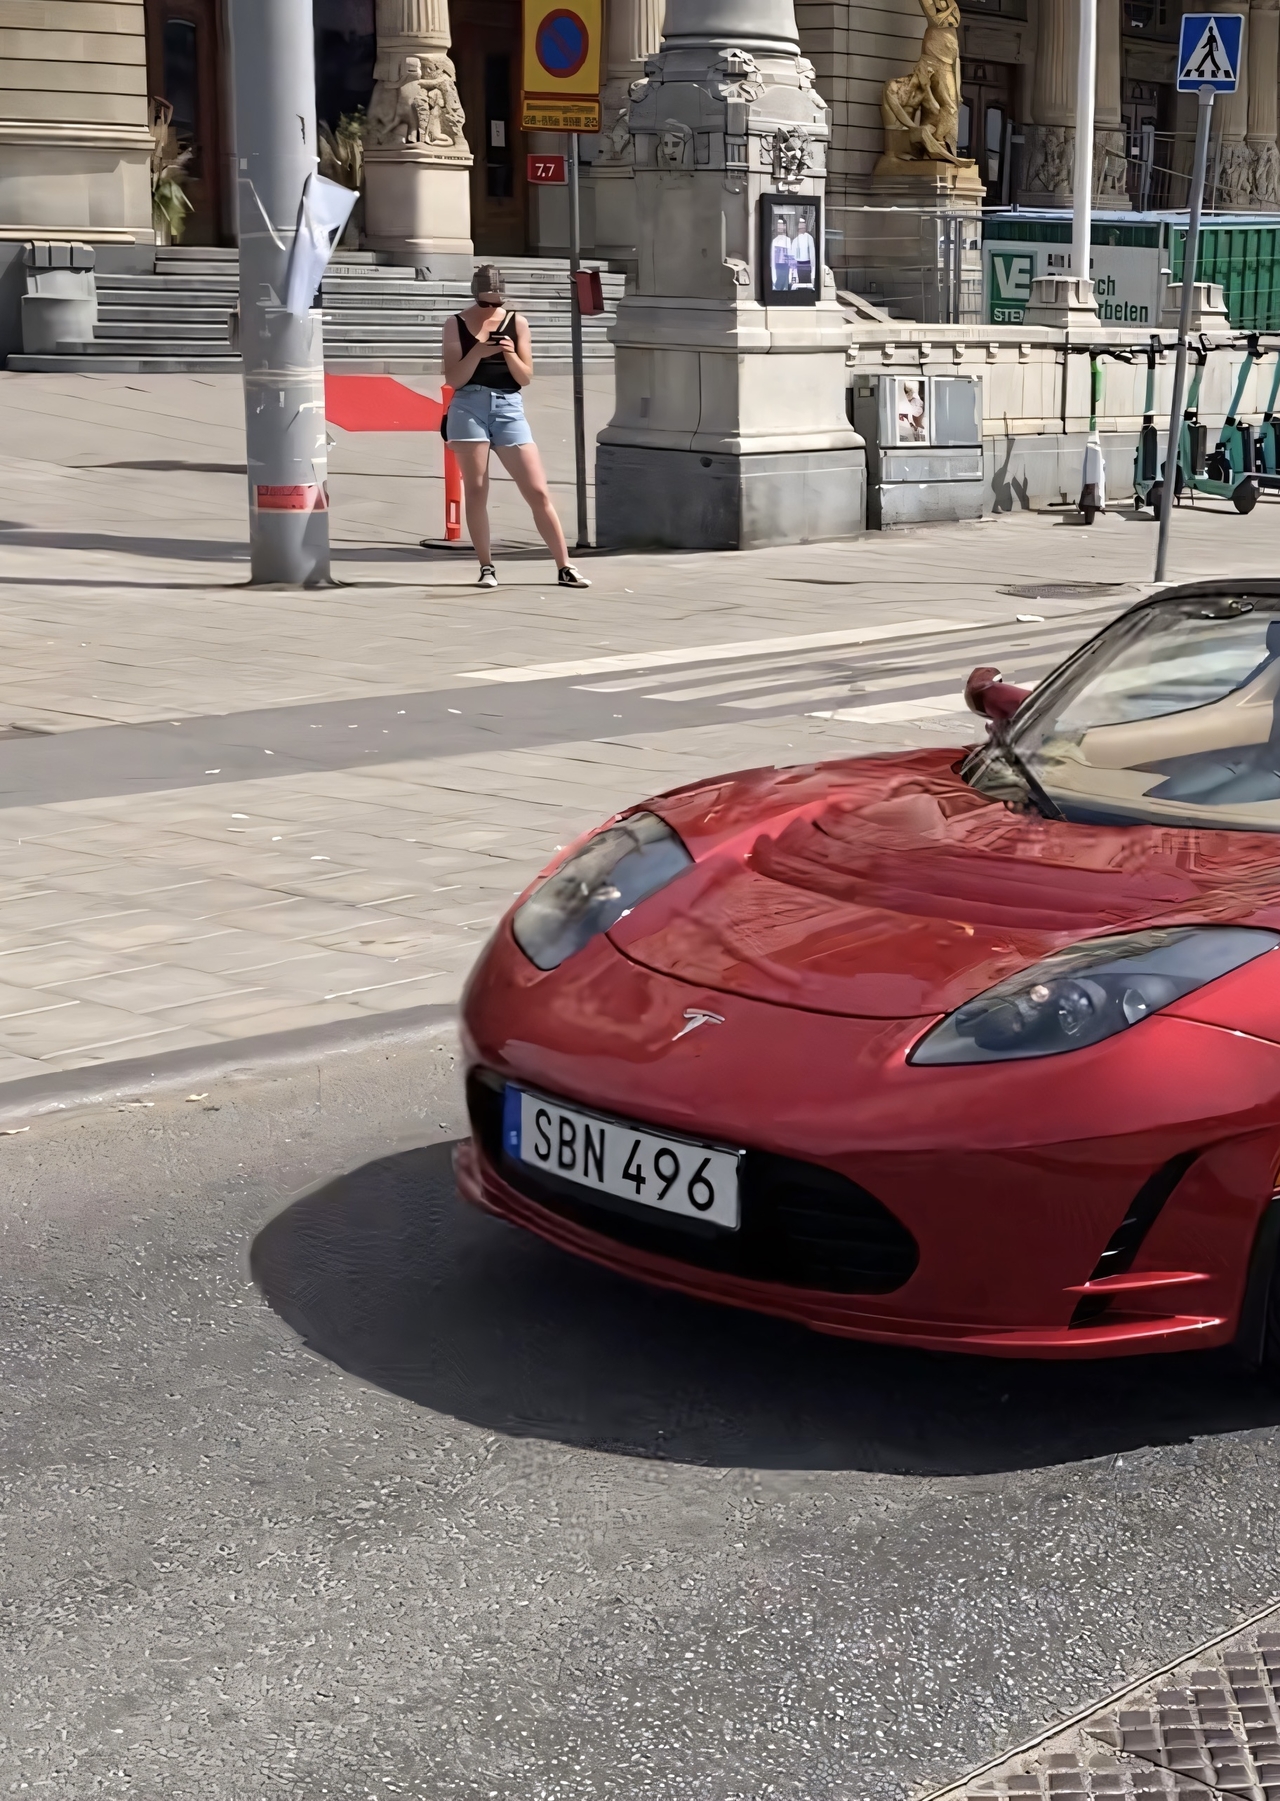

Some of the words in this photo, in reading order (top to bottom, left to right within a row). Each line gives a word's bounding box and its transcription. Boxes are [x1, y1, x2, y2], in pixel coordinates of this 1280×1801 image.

[993, 256, 1031, 299] VE
[1097, 299, 1149, 323] rbeten
[534, 1108, 606, 1183] SBN
[622, 1139, 715, 1212] 496
